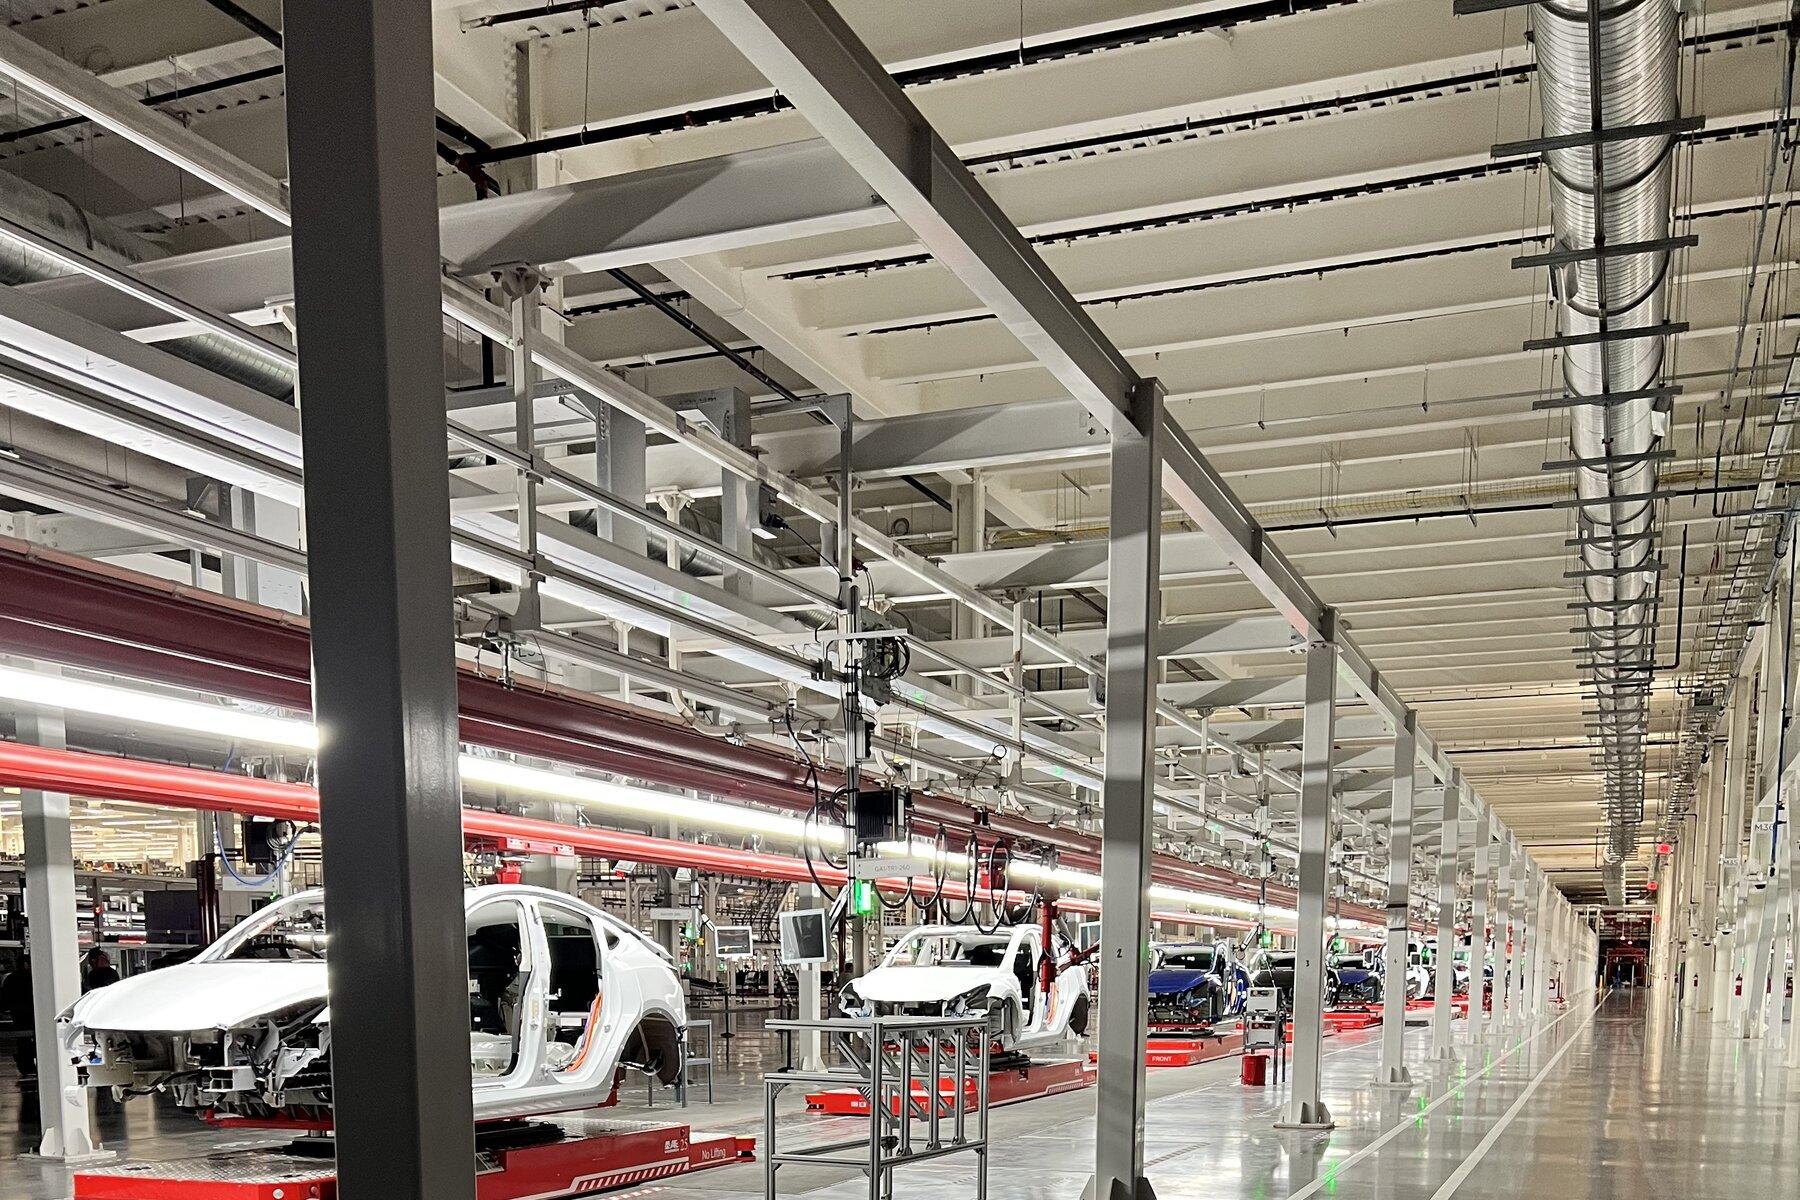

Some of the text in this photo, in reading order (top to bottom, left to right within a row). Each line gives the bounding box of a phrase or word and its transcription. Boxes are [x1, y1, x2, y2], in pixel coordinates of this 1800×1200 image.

[1116, 949, 1123, 958] 2
[702, 1148, 726, 1160] No Lifting
